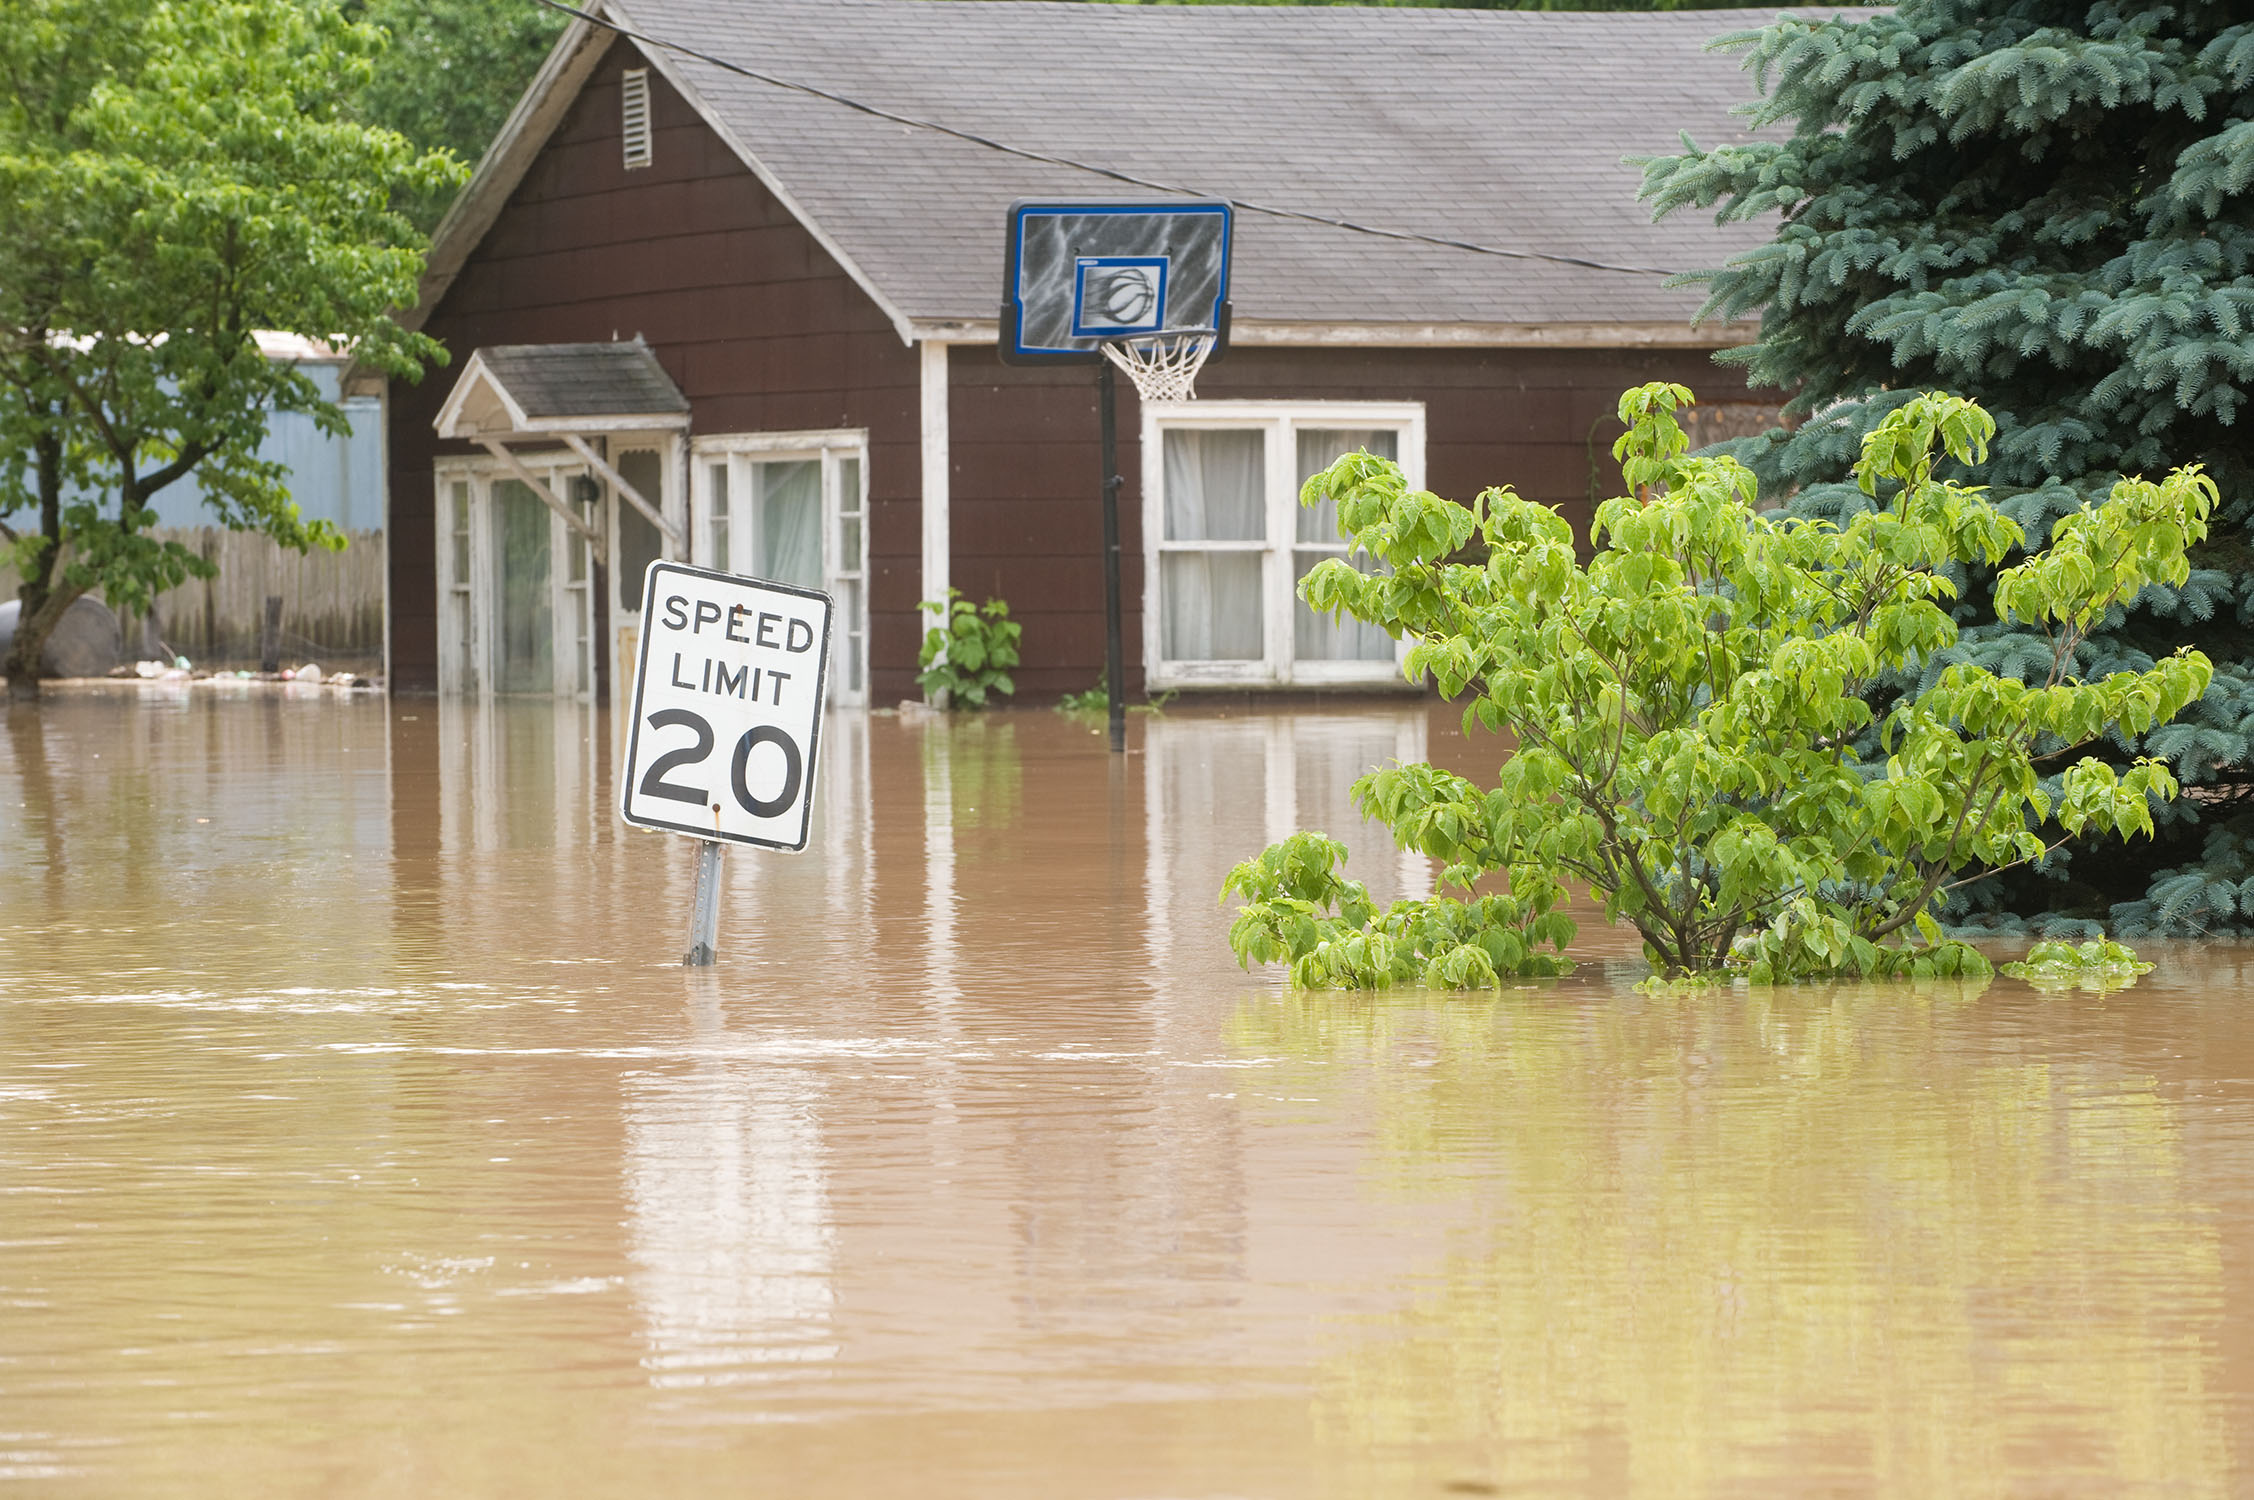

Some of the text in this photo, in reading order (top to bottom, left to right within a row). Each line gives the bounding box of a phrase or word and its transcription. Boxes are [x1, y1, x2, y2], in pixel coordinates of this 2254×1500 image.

[661, 595, 814, 654] SPEED
[671, 652, 792, 707] LIMIT
[639, 708, 803, 819] 20
